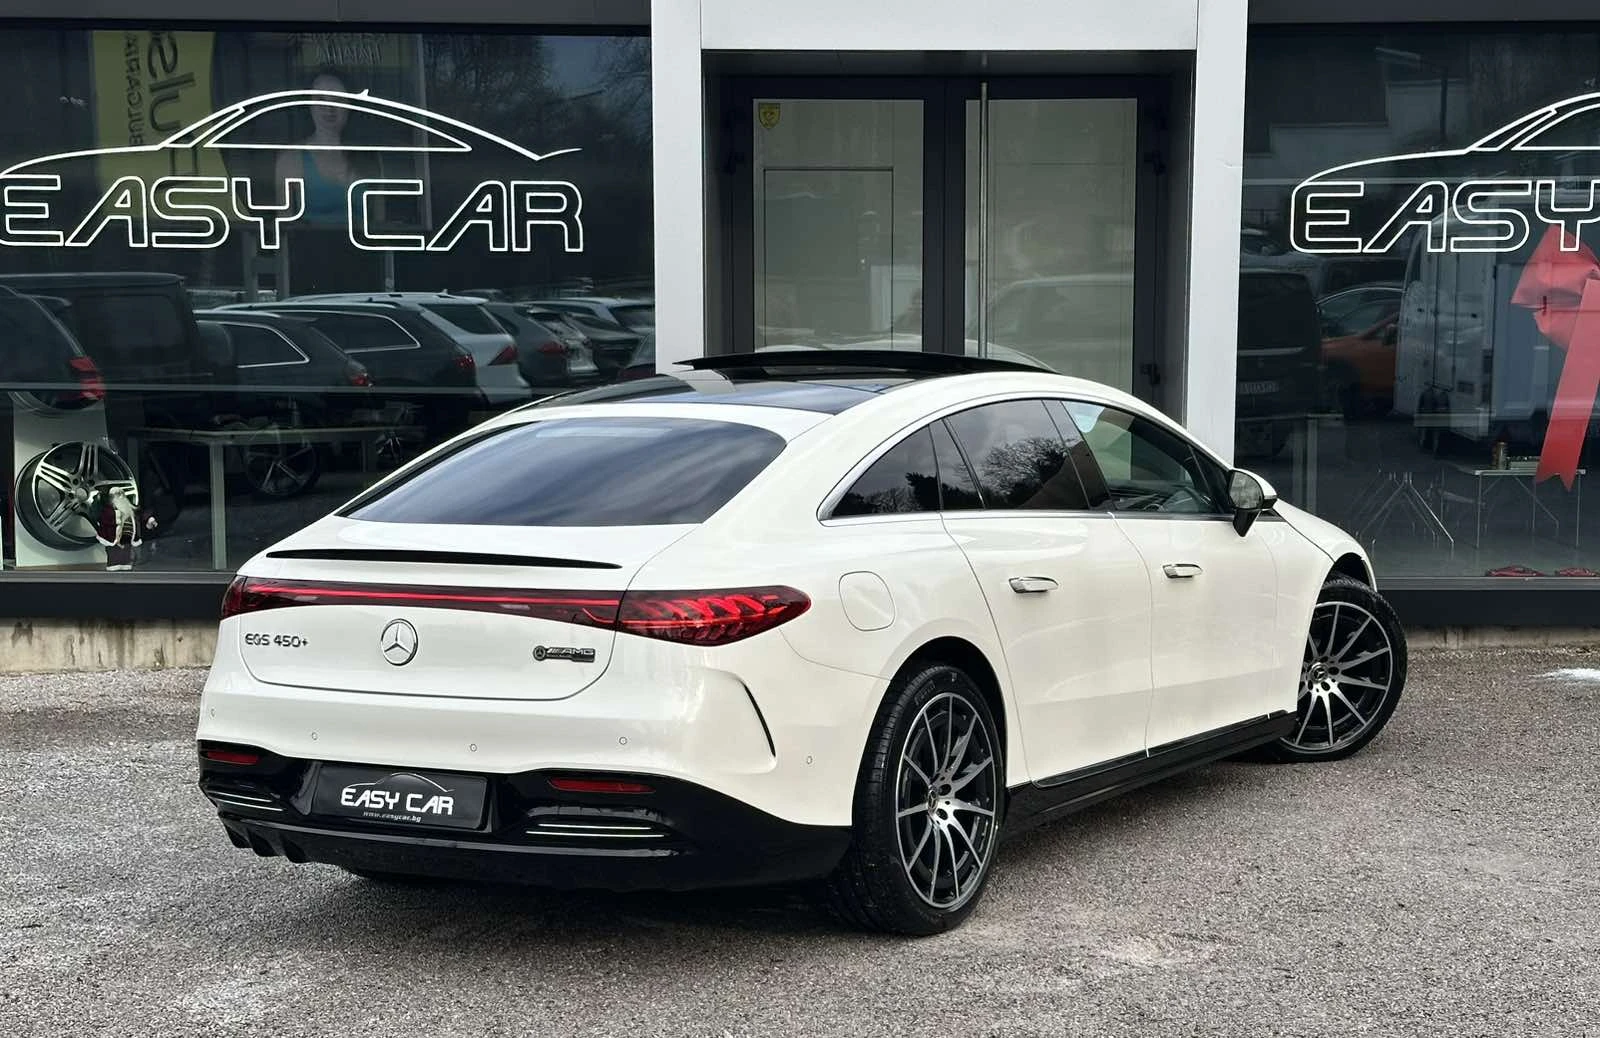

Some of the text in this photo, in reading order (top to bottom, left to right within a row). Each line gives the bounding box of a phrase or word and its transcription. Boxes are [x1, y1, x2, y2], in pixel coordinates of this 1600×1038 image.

[0, 175, 584, 253] EASY CAR
[1290, 179, 1600, 254] EASY
[245, 633, 308, 647] EQS 450+
[340, 787, 454, 815] EASY CAR
[364, 811, 421, 822] www.easycar.bg
